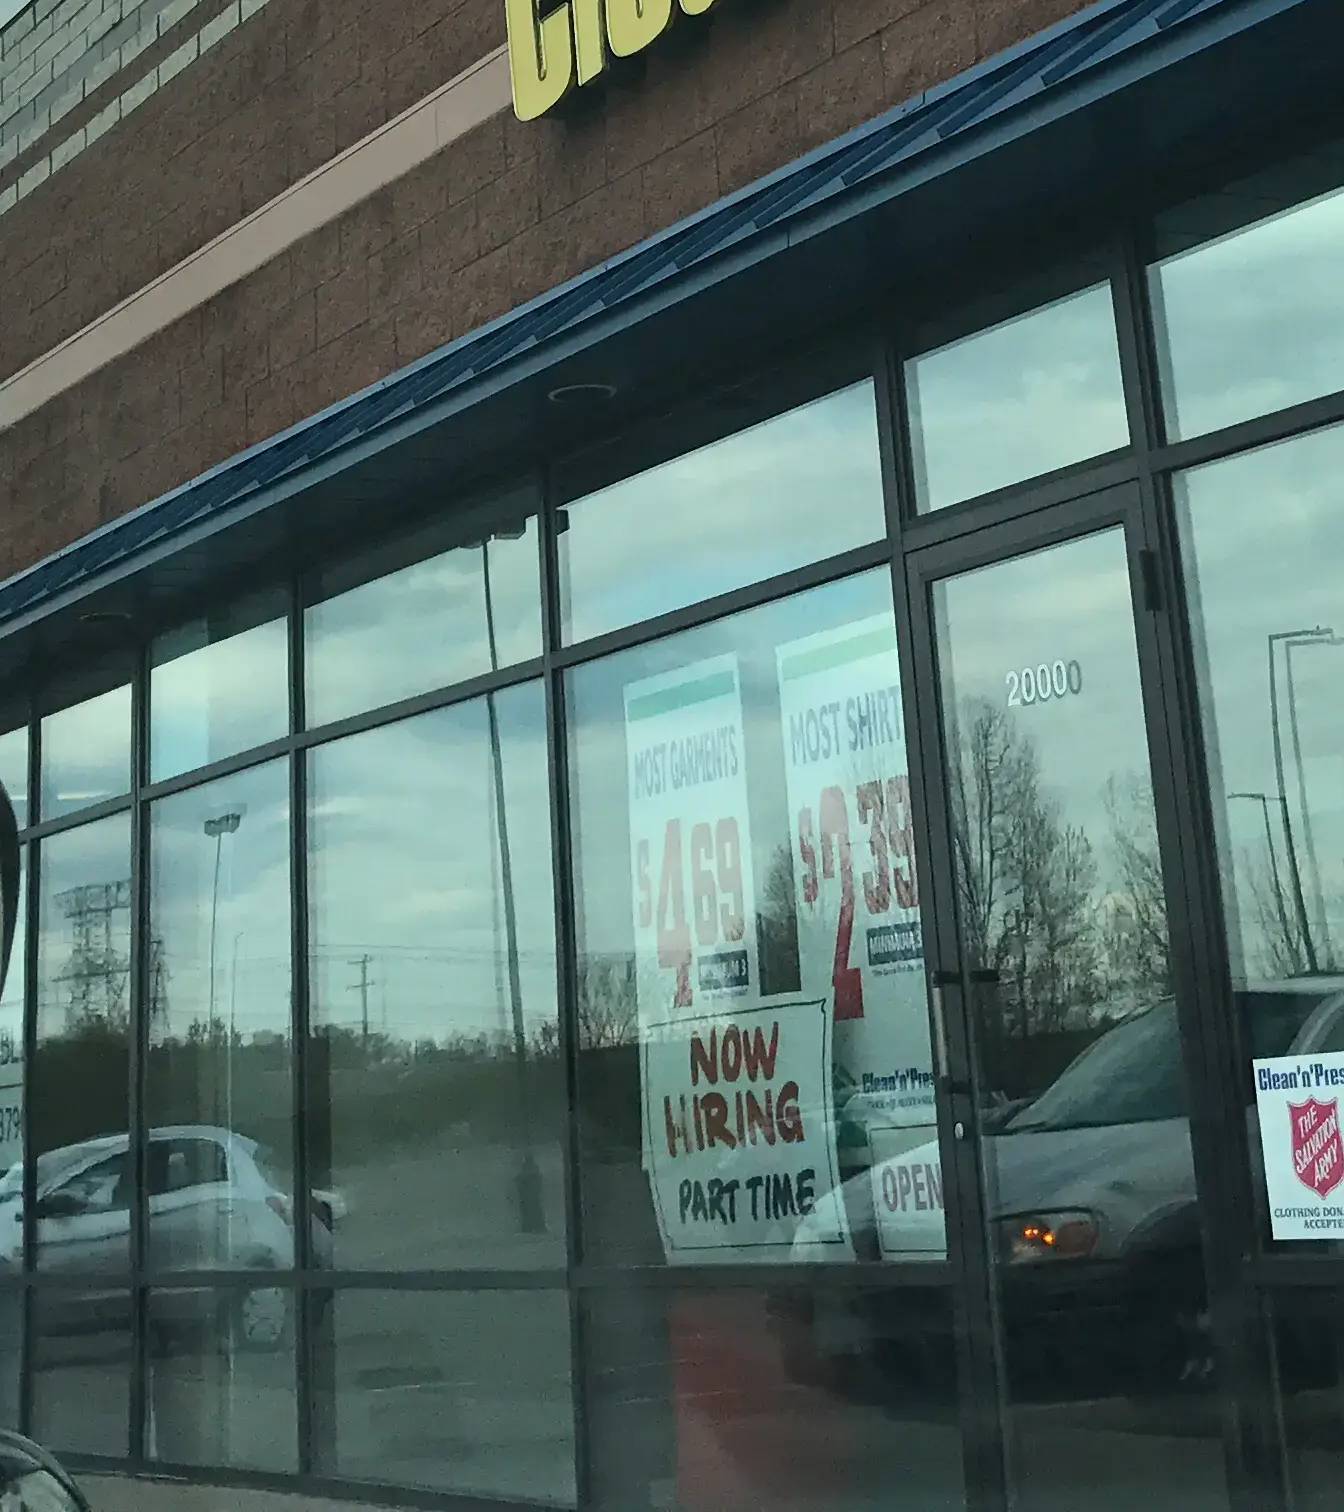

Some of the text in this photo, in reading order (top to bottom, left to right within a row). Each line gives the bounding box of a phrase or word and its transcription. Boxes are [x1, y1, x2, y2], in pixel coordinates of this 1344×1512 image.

[635, 725, 738, 798] MOST GARMENTS
[788, 702, 842, 766] MOST
[690, 1021, 779, 1086] NOW
[664, 1080, 805, 1158] HIRING
[1295, 1109, 1337, 1174] SALVATION
[1298, 1105, 1318, 1138] THE
[882, 1163, 944, 1212] OPEN
[1314, 1139, 1338, 1187] ARMY
[679, 1169, 816, 1225] PART TIME
[1274, 1207, 1321, 1218] CLOTHING
